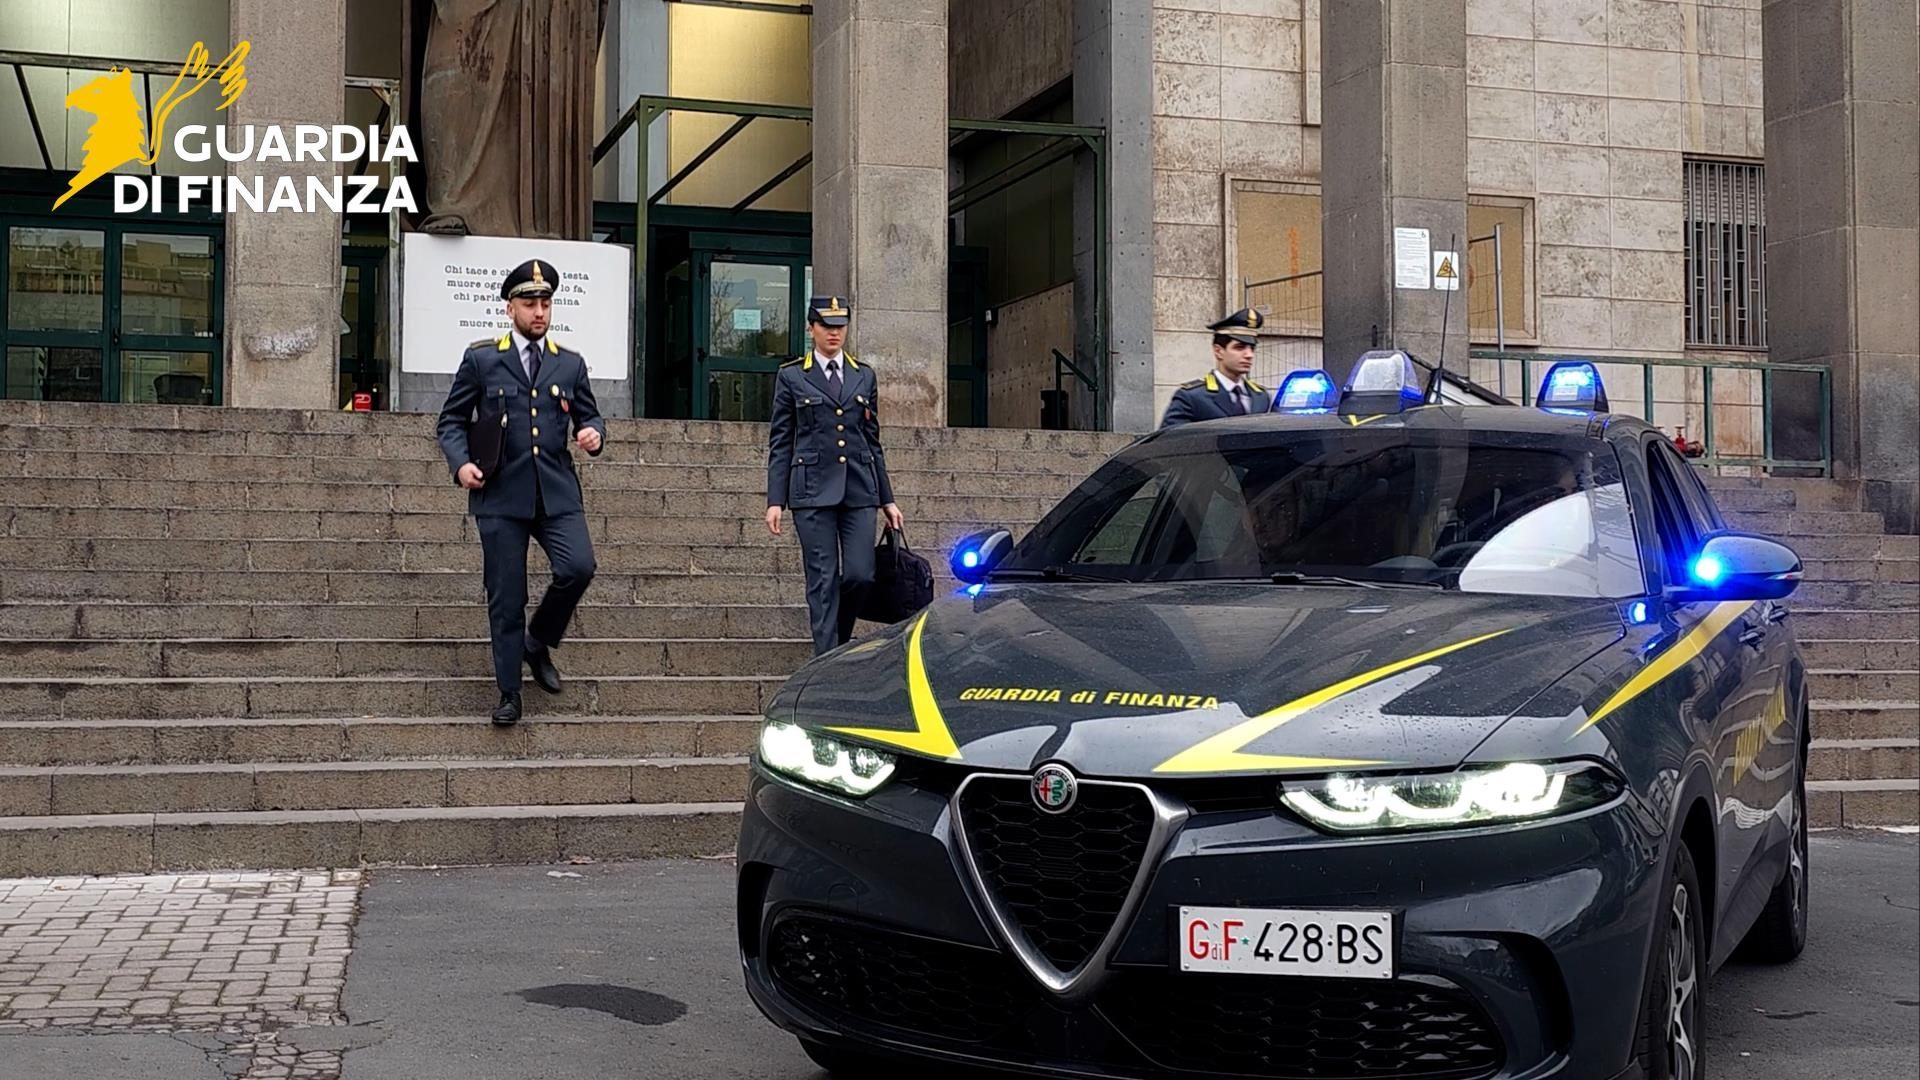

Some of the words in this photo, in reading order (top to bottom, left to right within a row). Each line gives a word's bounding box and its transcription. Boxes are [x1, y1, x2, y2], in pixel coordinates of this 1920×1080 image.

[444, 265, 462, 274] Chi
[466, 267, 488, 275] tace
[500, 268, 512, 276] ch
[562, 272, 589, 280] testa
[447, 280, 481, 288] muore
[484, 282, 503, 290] ogn
[560, 284, 570, 292] lo
[453, 292, 470, 301] chi
[473, 294, 502, 302] parla
[459, 320, 493, 328] muore
[959, 687, 1062, 702] GUARDIA
[1070, 690, 1097, 704] di
[1103, 691, 1219, 709] FINANZA
